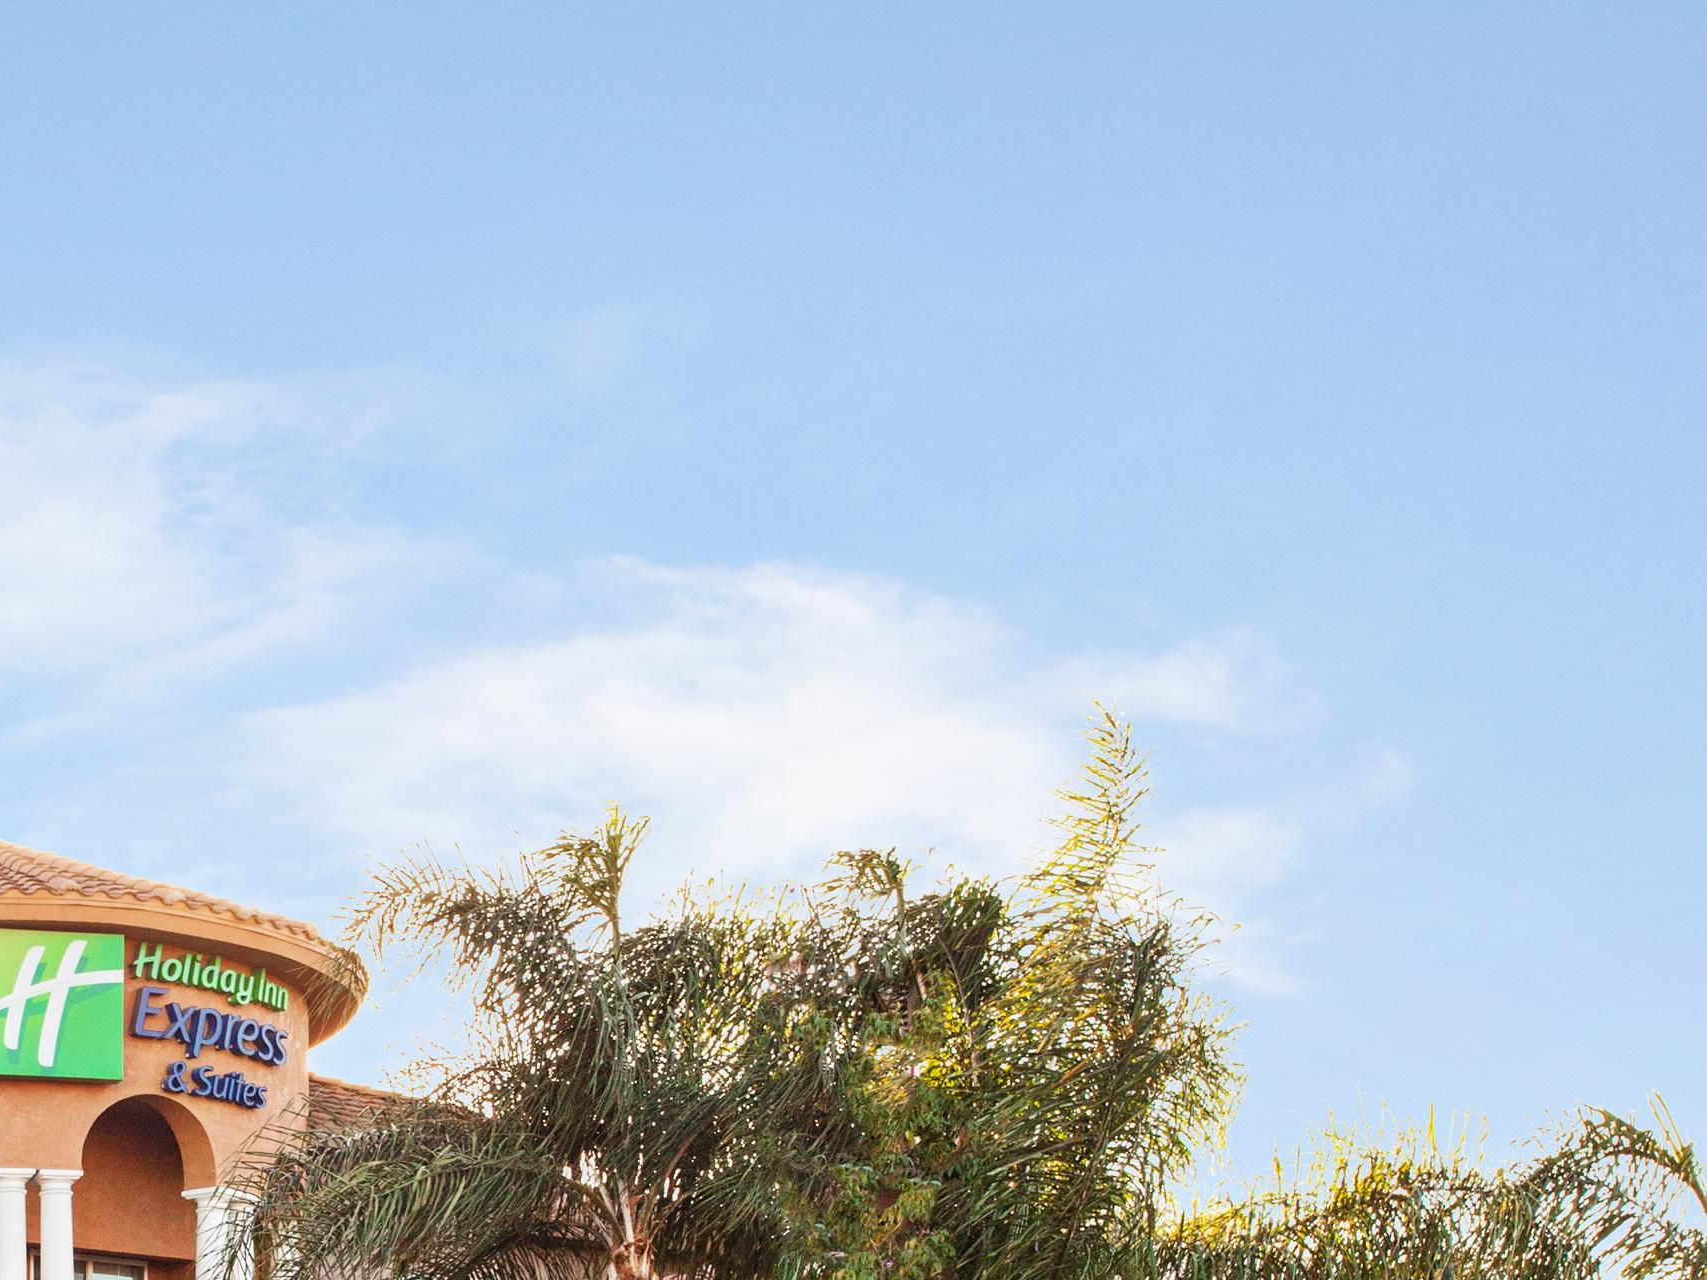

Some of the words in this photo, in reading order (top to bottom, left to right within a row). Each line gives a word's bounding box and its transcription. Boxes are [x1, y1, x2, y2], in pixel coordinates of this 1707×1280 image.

[133, 942, 254, 1005] Holiday
[257, 968, 288, 1012] Inn
[132, 986, 289, 1066] Express
[164, 1061, 188, 1094] &
[192, 1065, 268, 1109] Suites
